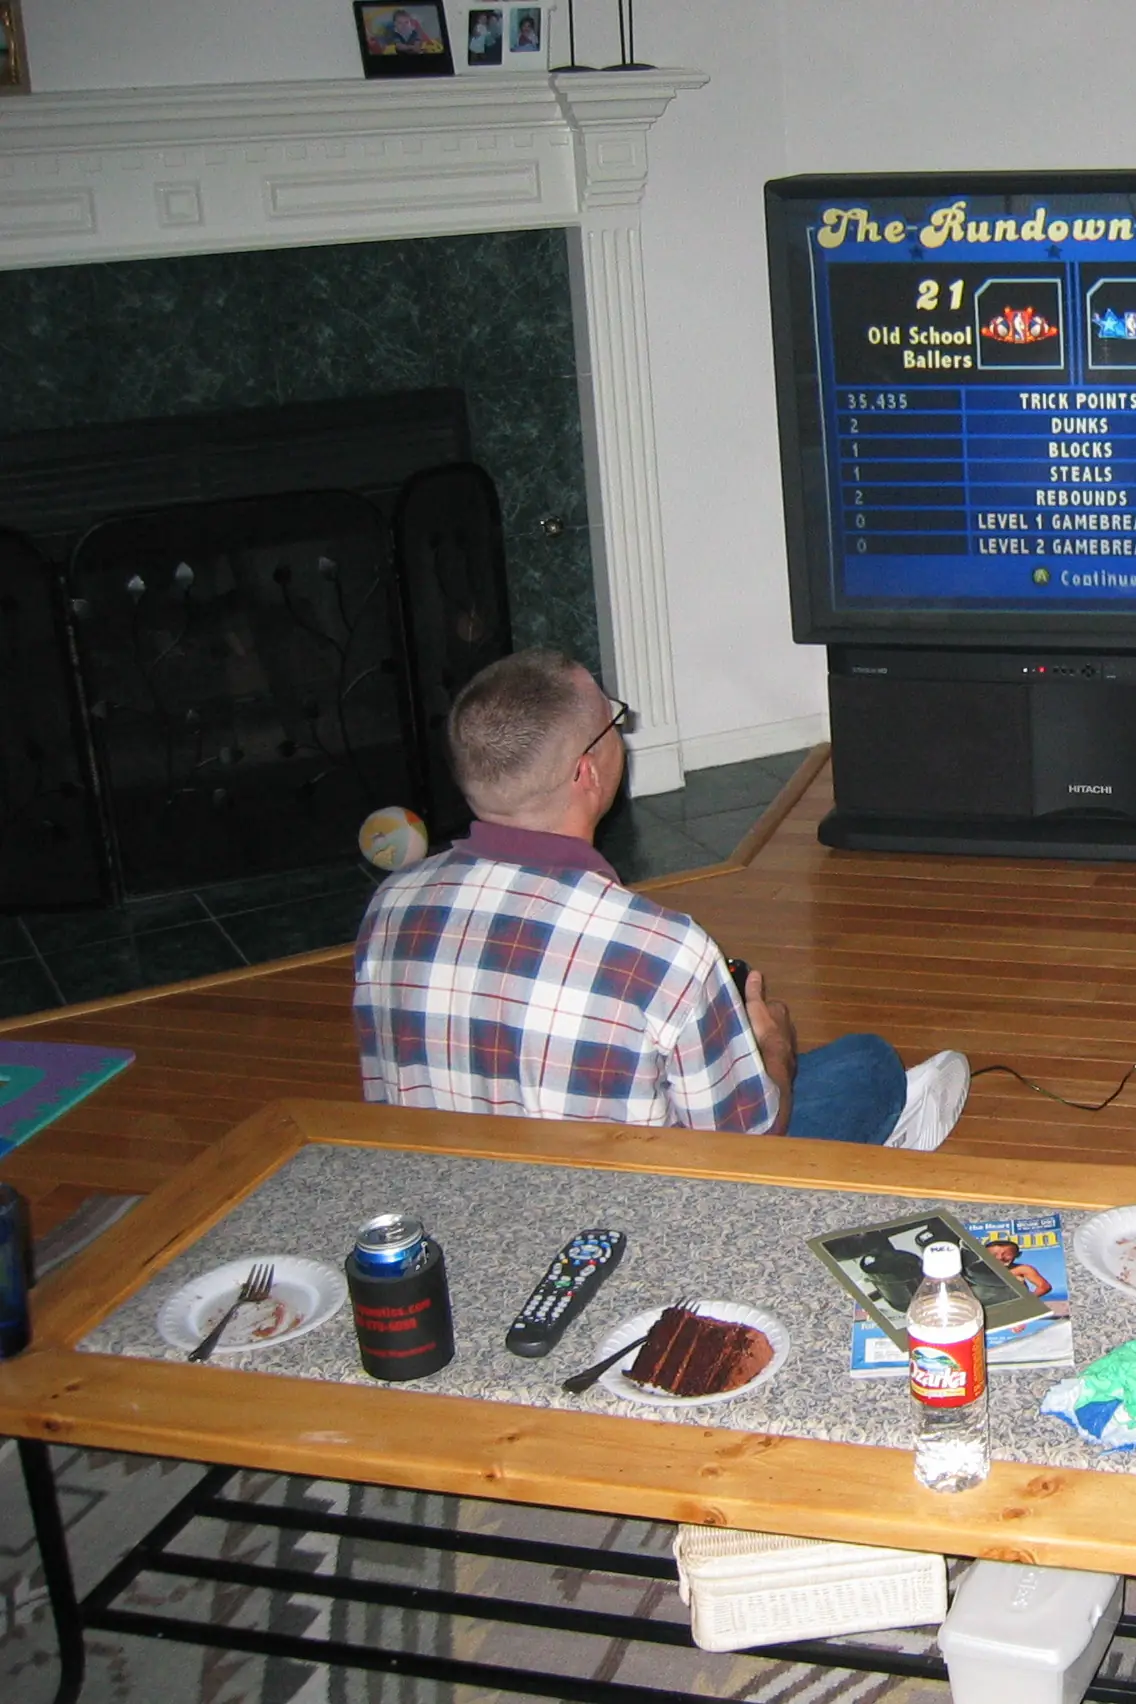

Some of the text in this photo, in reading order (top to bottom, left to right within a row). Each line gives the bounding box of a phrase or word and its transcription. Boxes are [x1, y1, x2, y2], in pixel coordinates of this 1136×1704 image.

[817, 201, 1134, 248] The Rundown
[916, 279, 964, 311] 21
[868, 326, 972, 345] Old School
[904, 350, 972, 369] Ballers
[1020, 393, 1069, 410] TRICK
[850, 418, 859, 433] 2
[1052, 417, 1108, 434] DUNKS
[852, 442, 858, 458] 1
[1049, 442, 1113, 458] BLOCKS
[853, 466, 860, 481] 1
[1050, 466, 1112, 482] STEALS
[855, 490, 863, 505] 2
[1036, 490, 1128, 506] REBOUNDS
[856, 514, 865, 528] 0
[978, 513, 1028, 529] LEVEL
[1036, 514, 1043, 529] 1
[857, 538, 867, 553] 0
[979, 538, 1029, 554] LEVEL
[1036, 539, 1045, 554] 2
[1068, 784, 1112, 794] HITACHI
